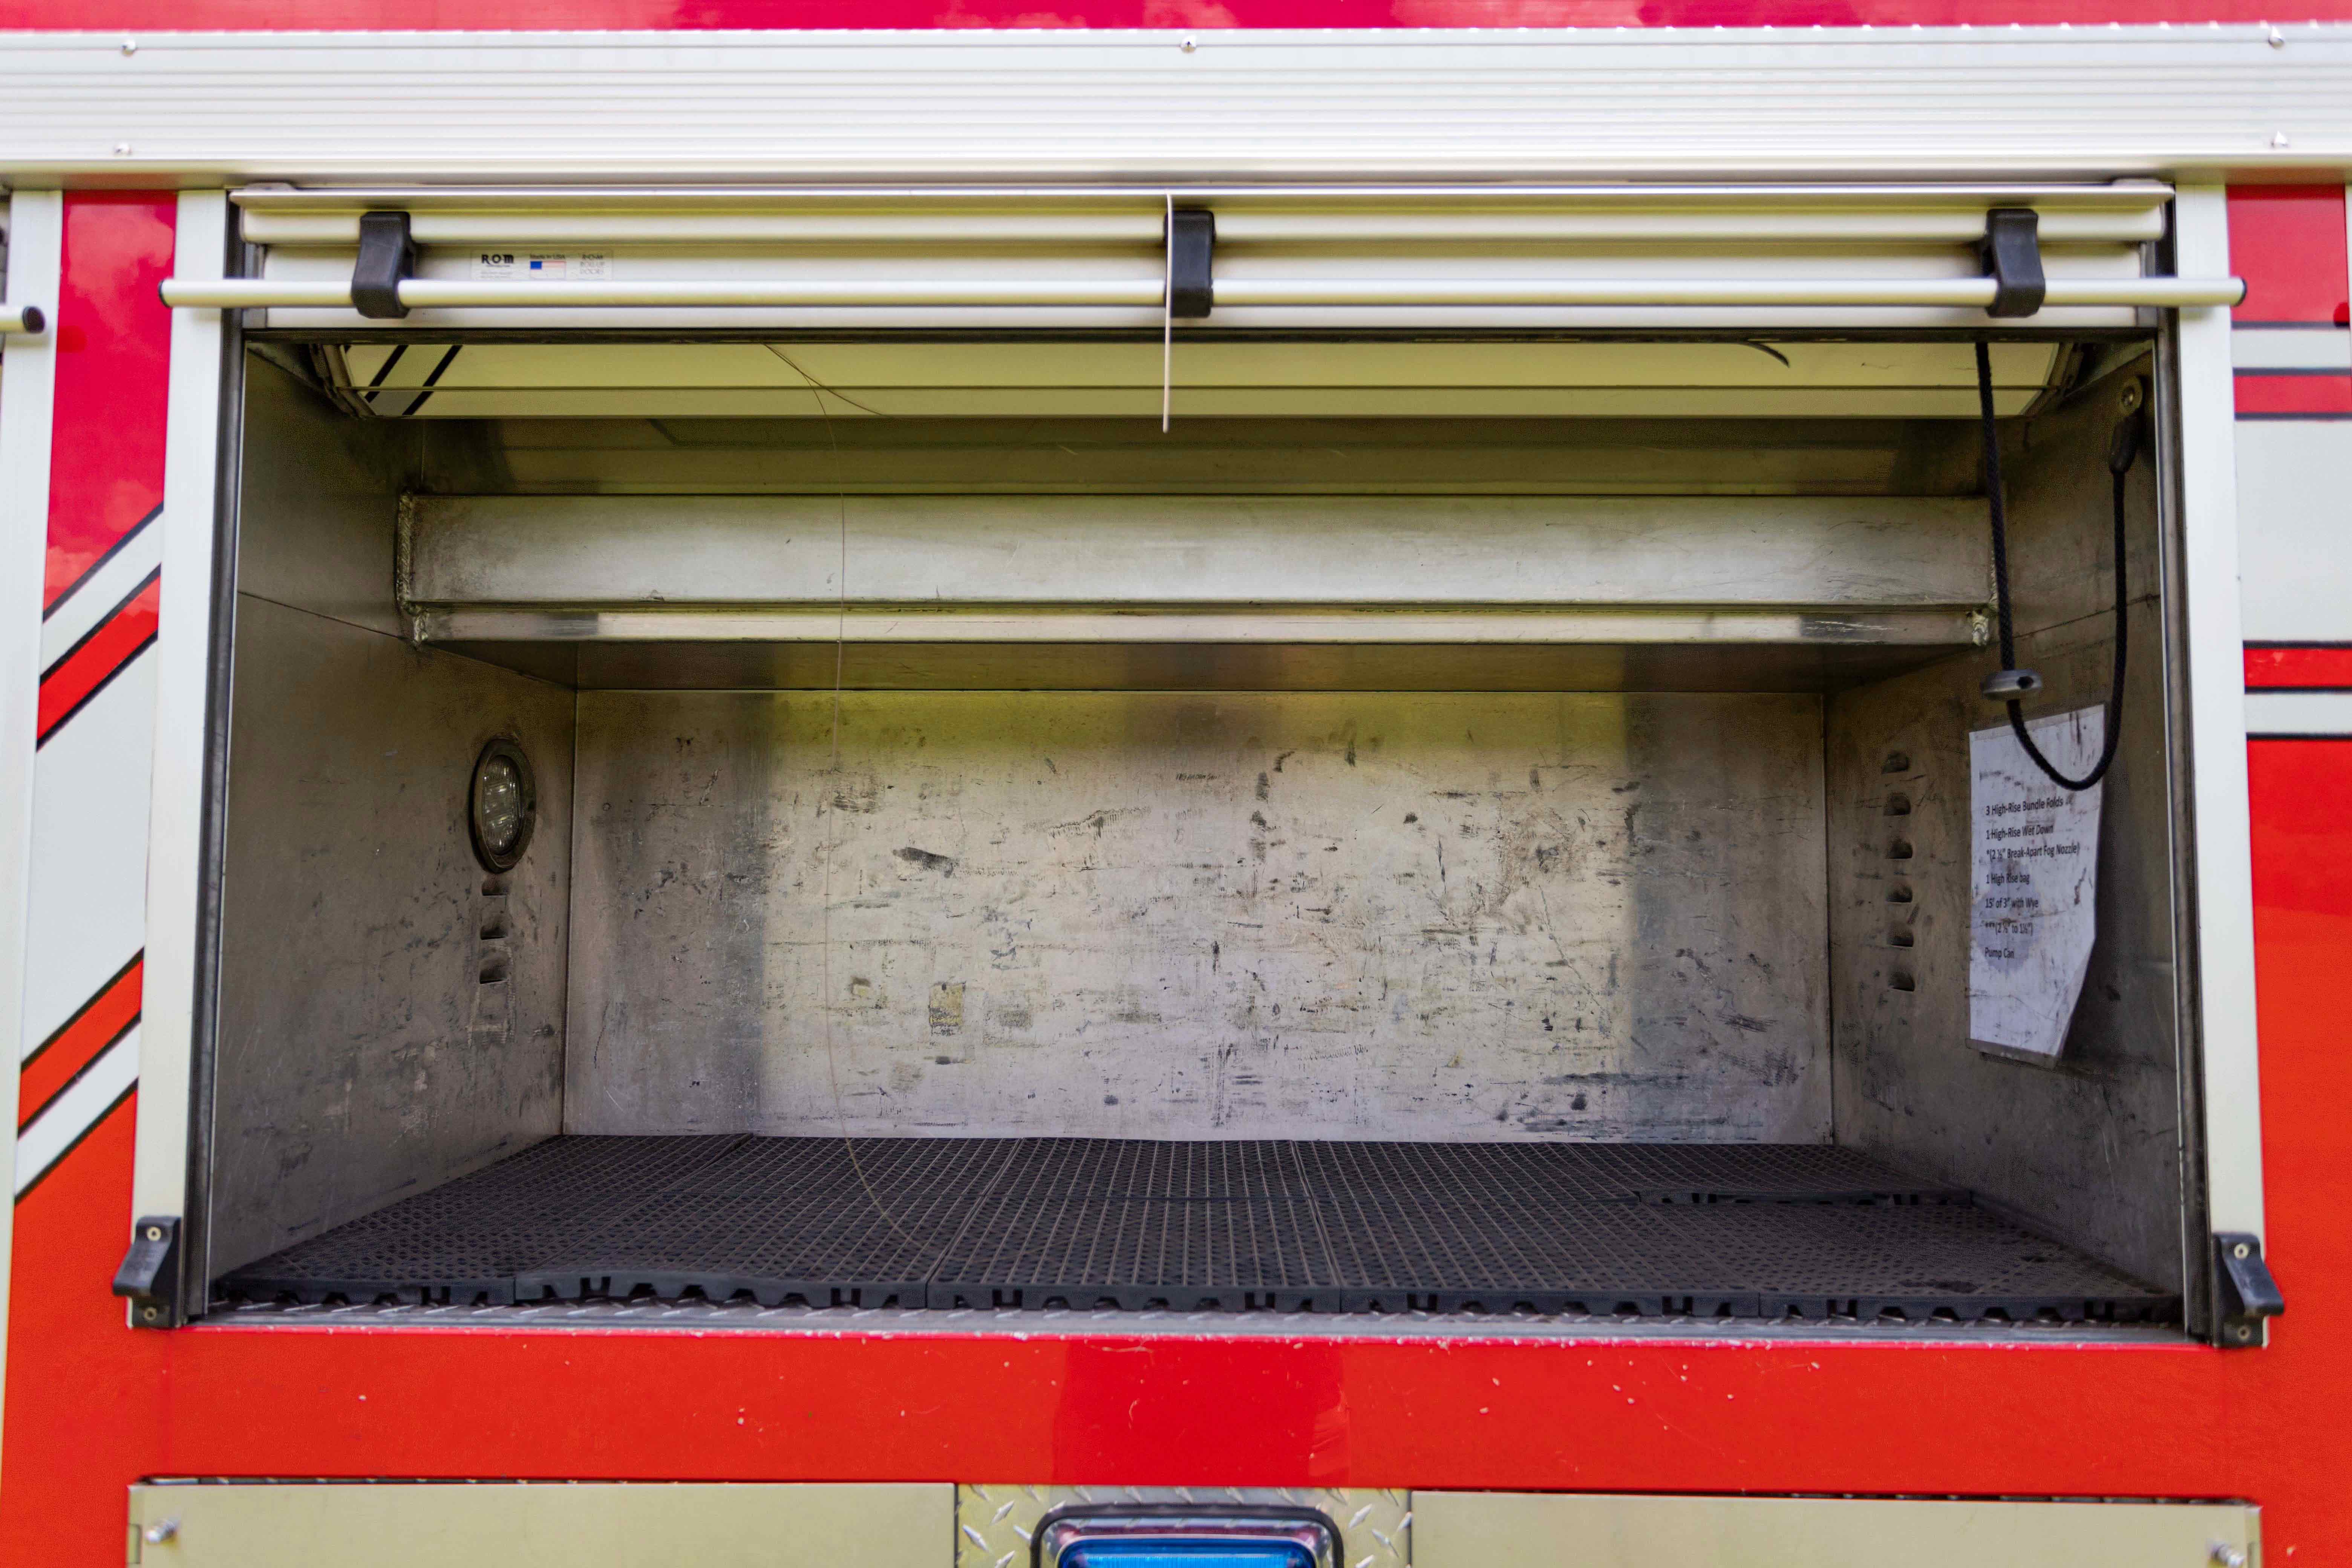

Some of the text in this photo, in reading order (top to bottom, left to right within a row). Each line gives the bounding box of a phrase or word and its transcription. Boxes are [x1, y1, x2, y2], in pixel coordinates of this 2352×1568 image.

[1986, 796, 2064, 816] 3 High-Rise Bundle Folds
[1986, 824, 2054, 841] 1 High-Rise Wet Down
[2007, 847, 2042, 859] Break-Apart
[2043, 845, 2055, 858] Fog
[2056, 841, 2081, 856] Nozzle)
[1986, 872, 2030, 886] 1 High Rise bag
[1996, 897, 2002, 908] of
[2011, 897, 2024, 908] with
[2026, 897, 2039, 910] Wye
[2012, 924, 2018, 933] to
[1984, 947, 2015, 960] Pump Can
